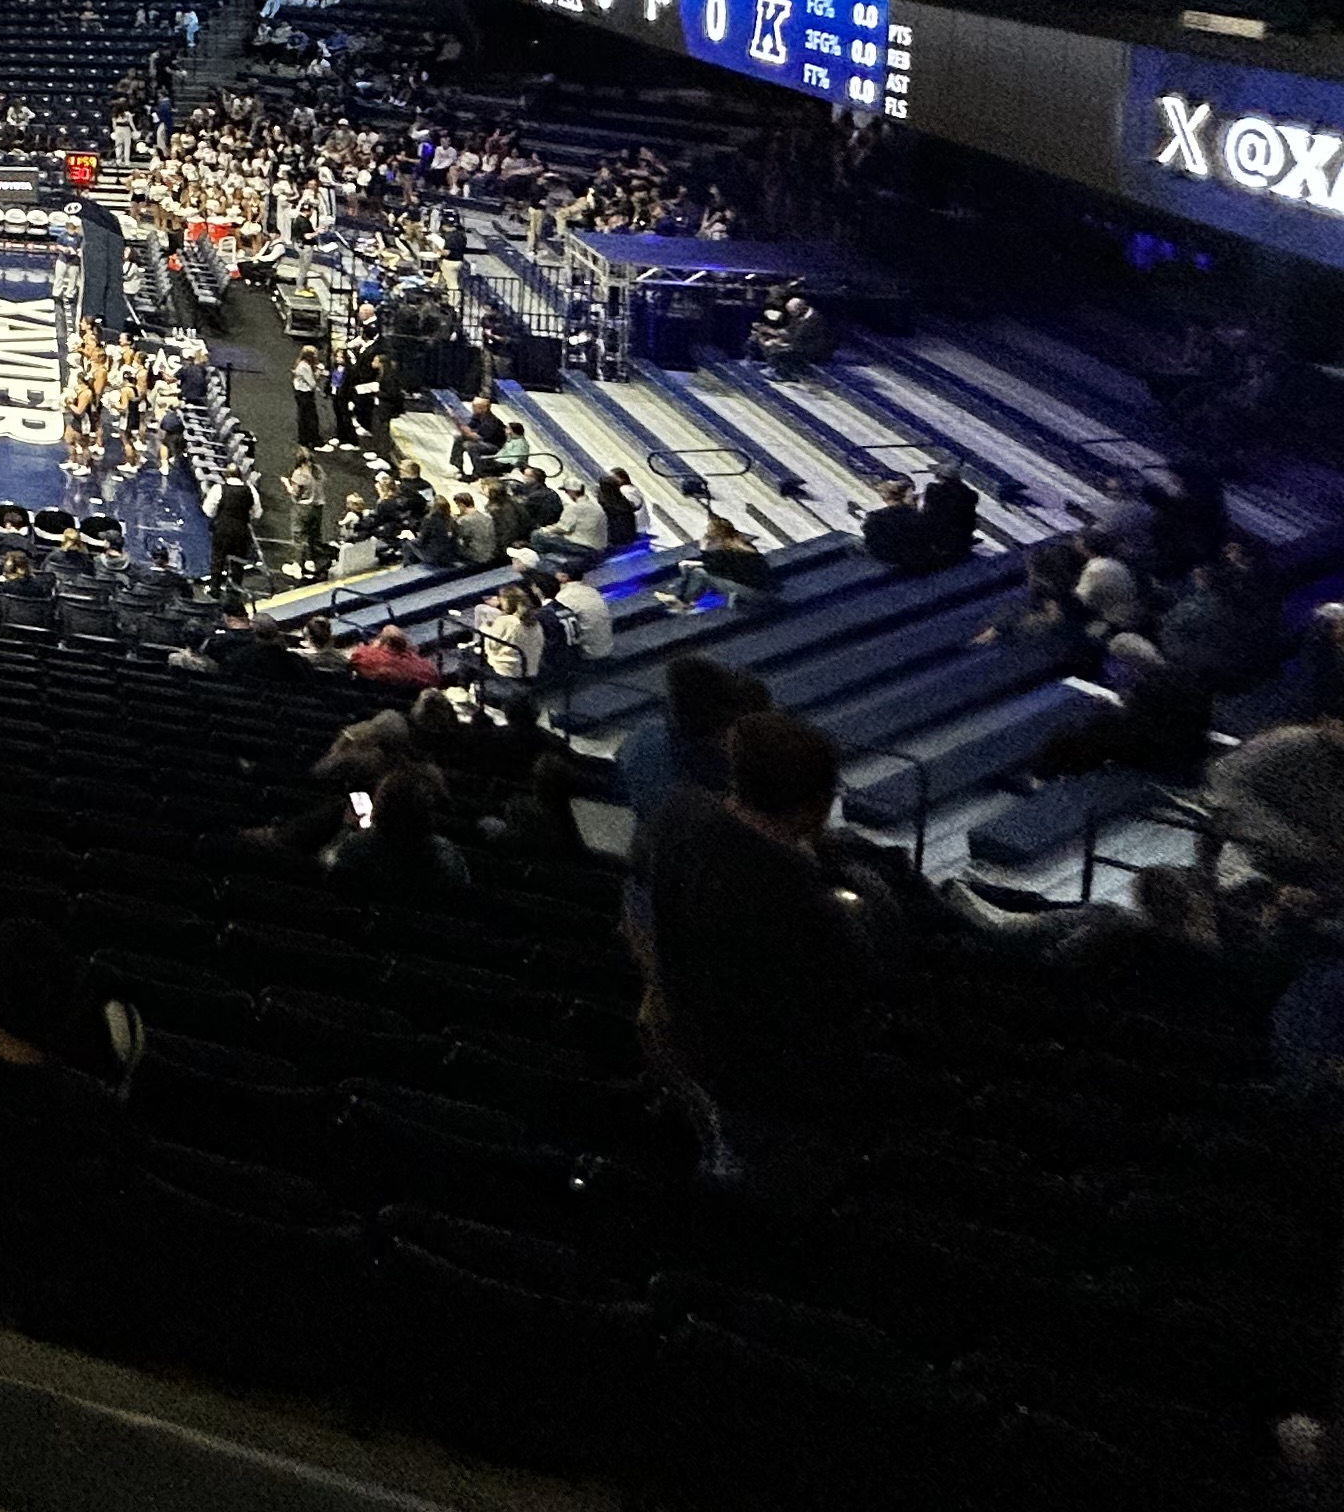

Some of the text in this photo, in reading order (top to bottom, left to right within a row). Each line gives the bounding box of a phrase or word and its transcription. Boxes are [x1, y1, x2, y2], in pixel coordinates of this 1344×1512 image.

[852, 2, 879, 29] 0.0
[804, 28, 877, 67] 3FG% 0.0
[888, 24, 912, 46] PTS
[803, 63, 875, 105] FT% 0.0
[885, 73, 911, 94] AST
[884, 96, 909, 119] FLS
[1157, 96, 1211, 175] X
[69, 168, 90, 181] 30
